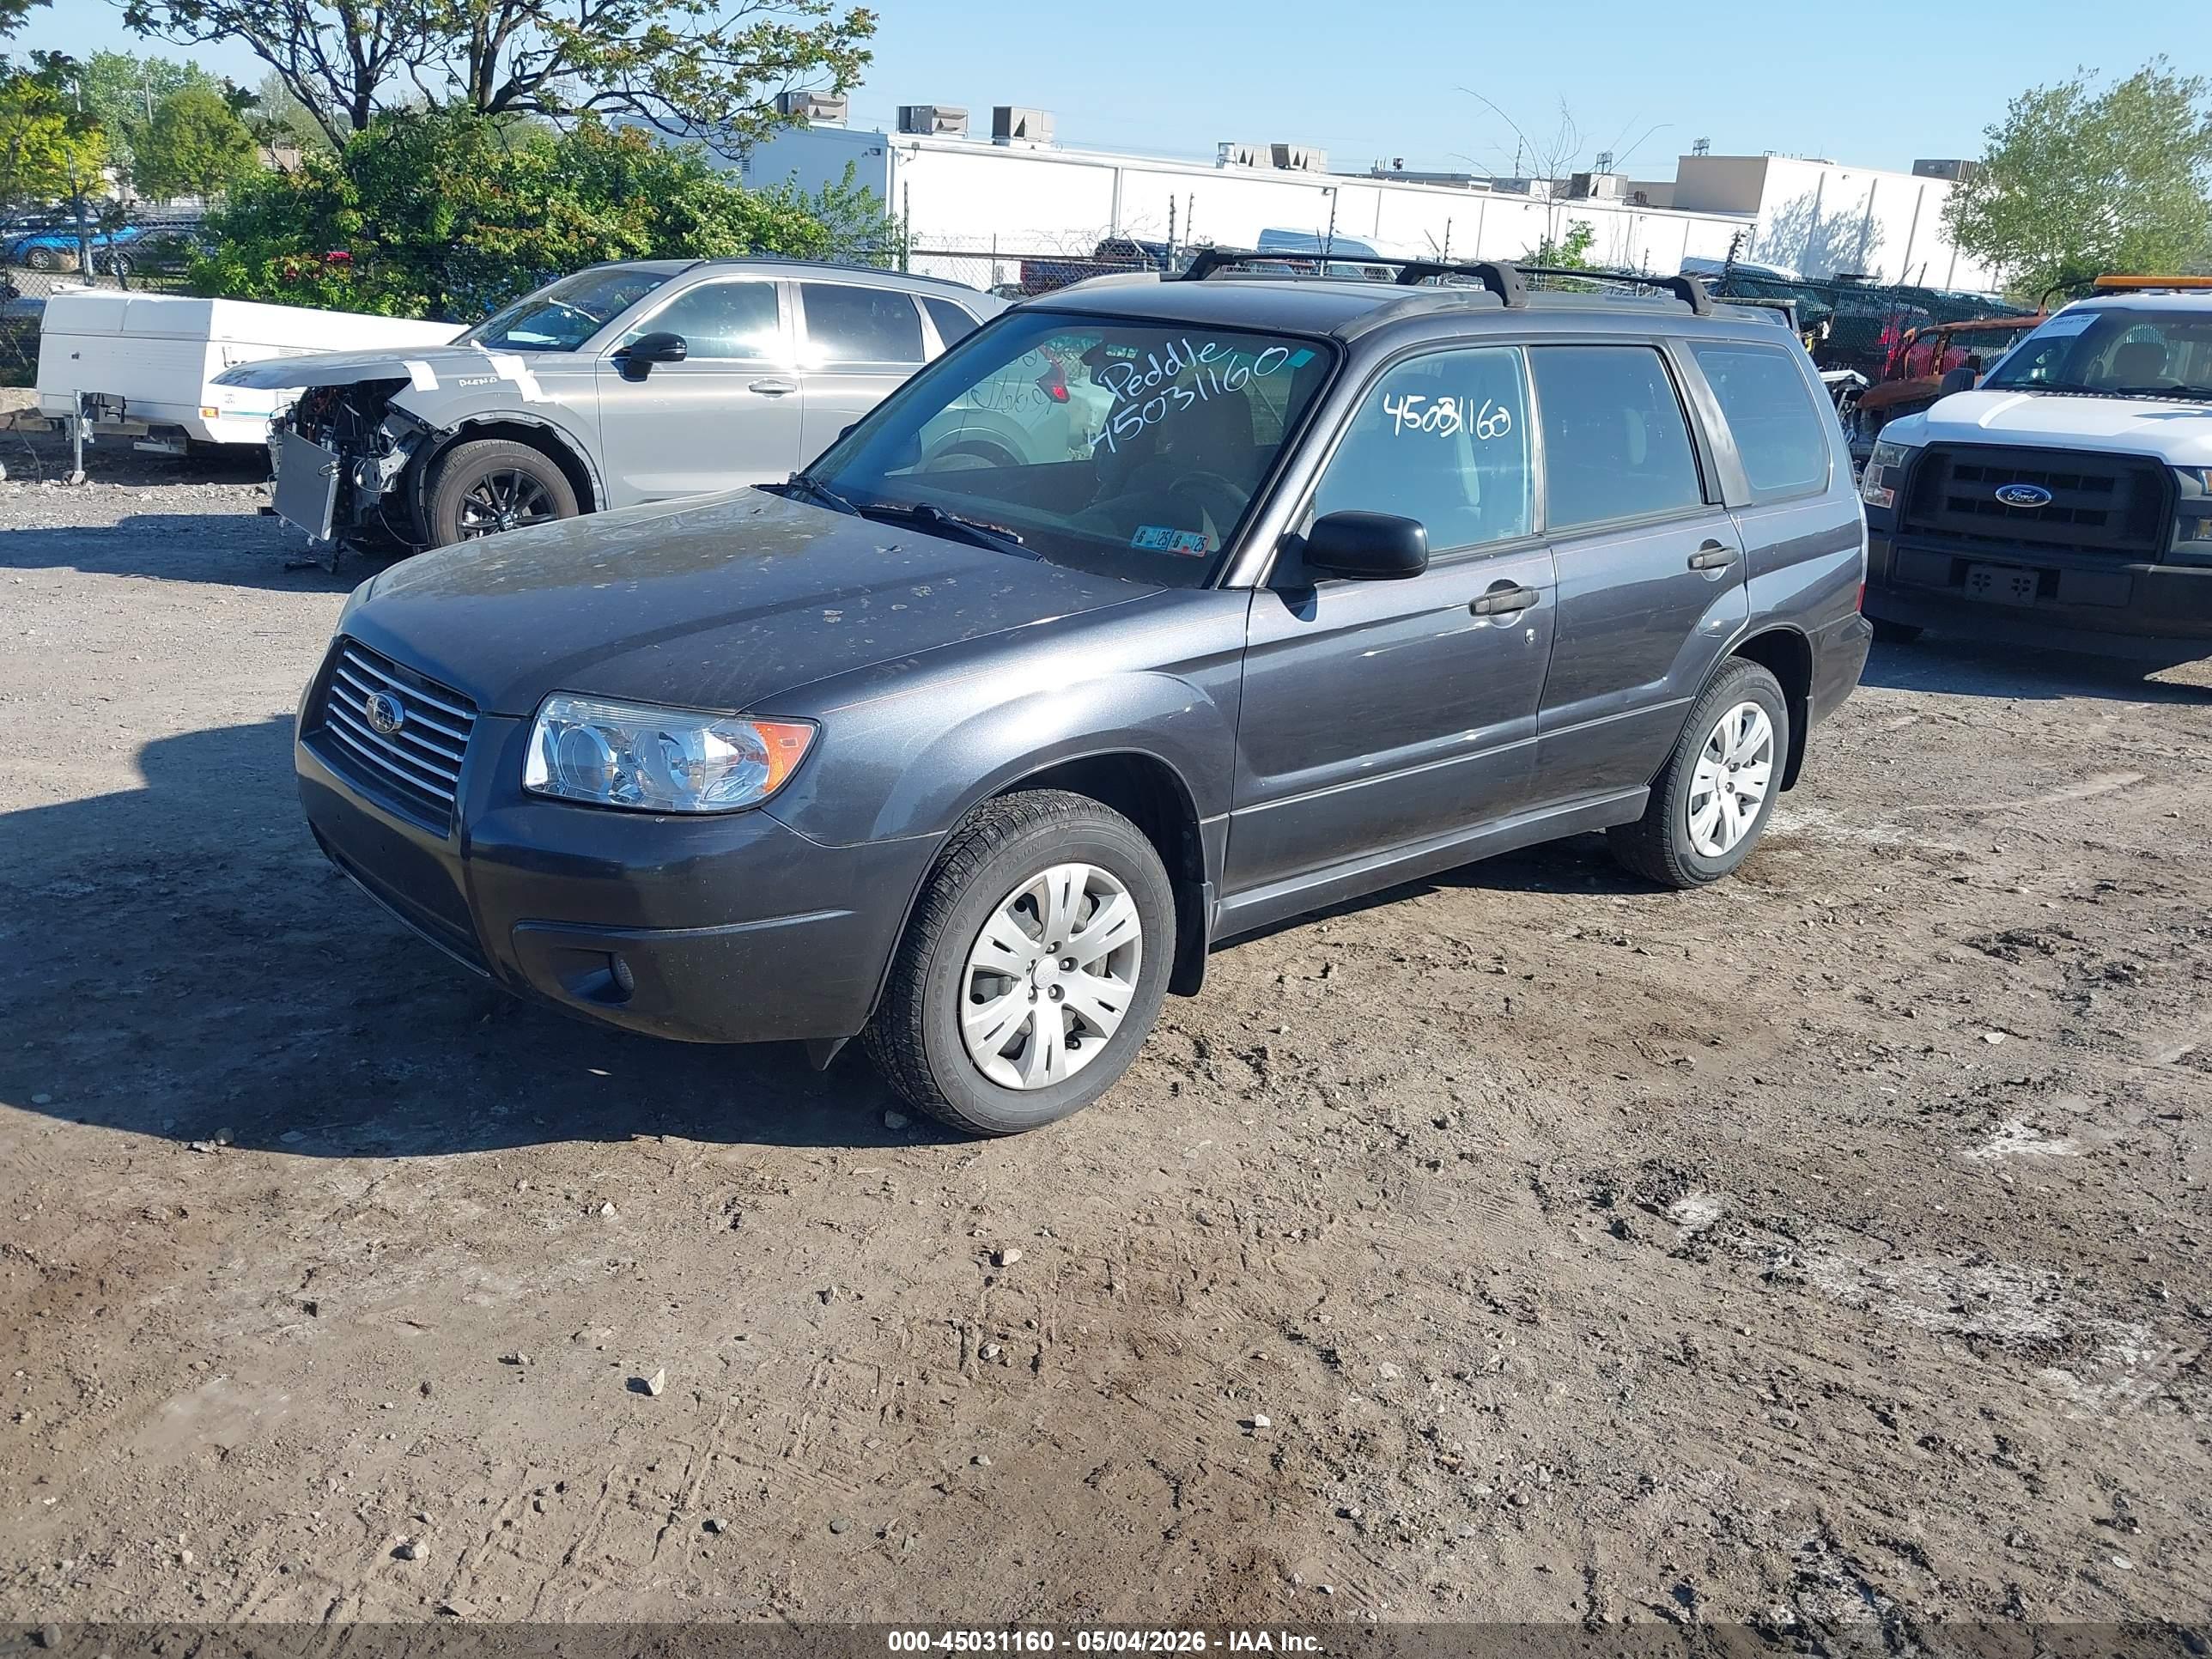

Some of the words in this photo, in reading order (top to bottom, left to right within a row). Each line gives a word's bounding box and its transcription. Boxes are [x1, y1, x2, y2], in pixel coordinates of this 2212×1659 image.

[1098, 337, 1233, 403] Peddle
[1088, 347, 1289, 453] 45031160
[1157, 532, 1171, 546] 25
[1194, 537, 1206, 552] 25
